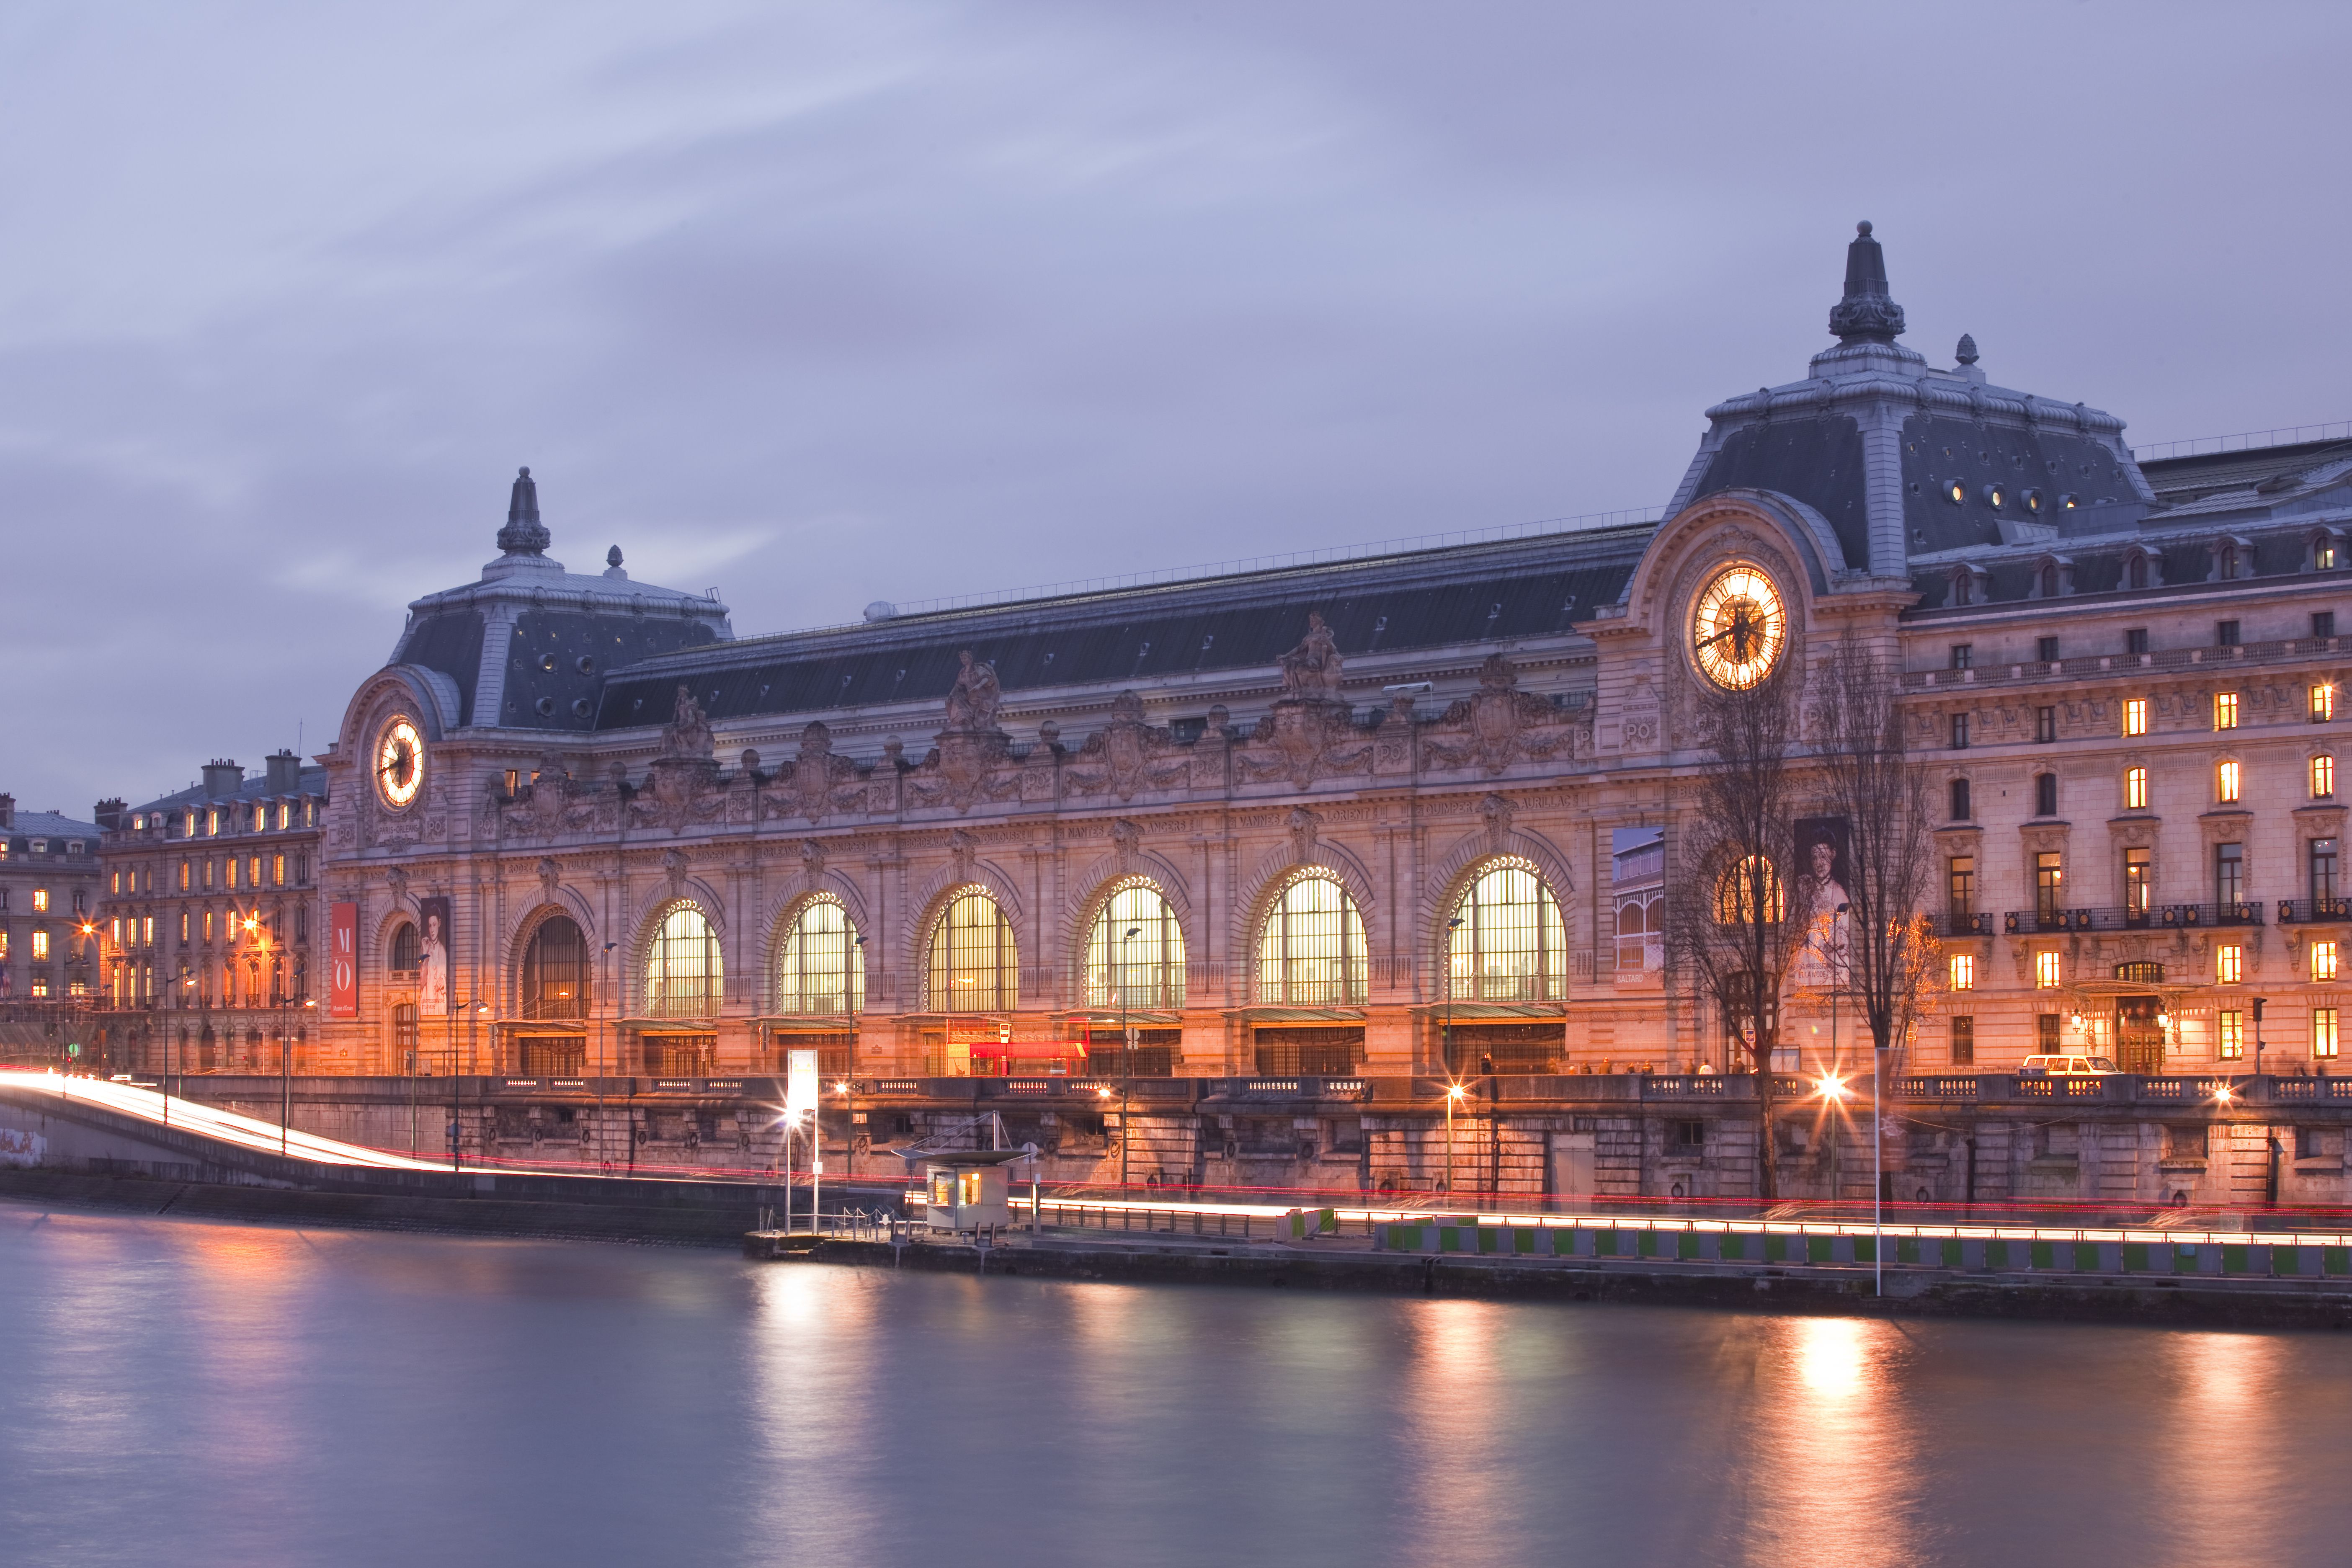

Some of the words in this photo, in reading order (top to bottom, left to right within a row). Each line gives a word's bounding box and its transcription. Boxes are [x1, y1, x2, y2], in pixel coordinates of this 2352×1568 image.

[1581, 730, 1595, 746] P
[1627, 723, 1650, 740] PO
[1380, 746, 1401, 760] PO
[1197, 762, 1215, 775] PO
[1028, 775, 1045, 788] PO
[873, 788, 888, 800] PO
[730, 799, 744, 811] PO
[1426, 802, 1473, 815] QUIMPER
[1521, 795, 1571, 809] AURILLAC
[599, 810, 611, 821] PO
[1240, 814, 1279, 827] VANNES
[1327, 808, 1369, 822] LORIENT
[379, 824, 418, 835] PARIS-ORLEANS
[429, 821, 441, 833] PO
[478, 819, 490, 830] PO
[1068, 826, 1104, 838] NANTES
[1148, 820, 1185, 833] ANGERS
[340, 828, 351, 839] PO
[905, 836, 946, 848] BORDEAUX
[979, 831, 1021, 843] TOULOUSE
[763, 846, 797, 857] ORLEANS
[830, 841, 866, 852] BOURGES
[509, 864, 533, 873] RODEZ
[567, 860, 591, 869] TULLE
[628, 855, 660, 866] POITIERS
[338, 928, 351, 953] M
[1617, 975, 1643, 983] BALTARD
